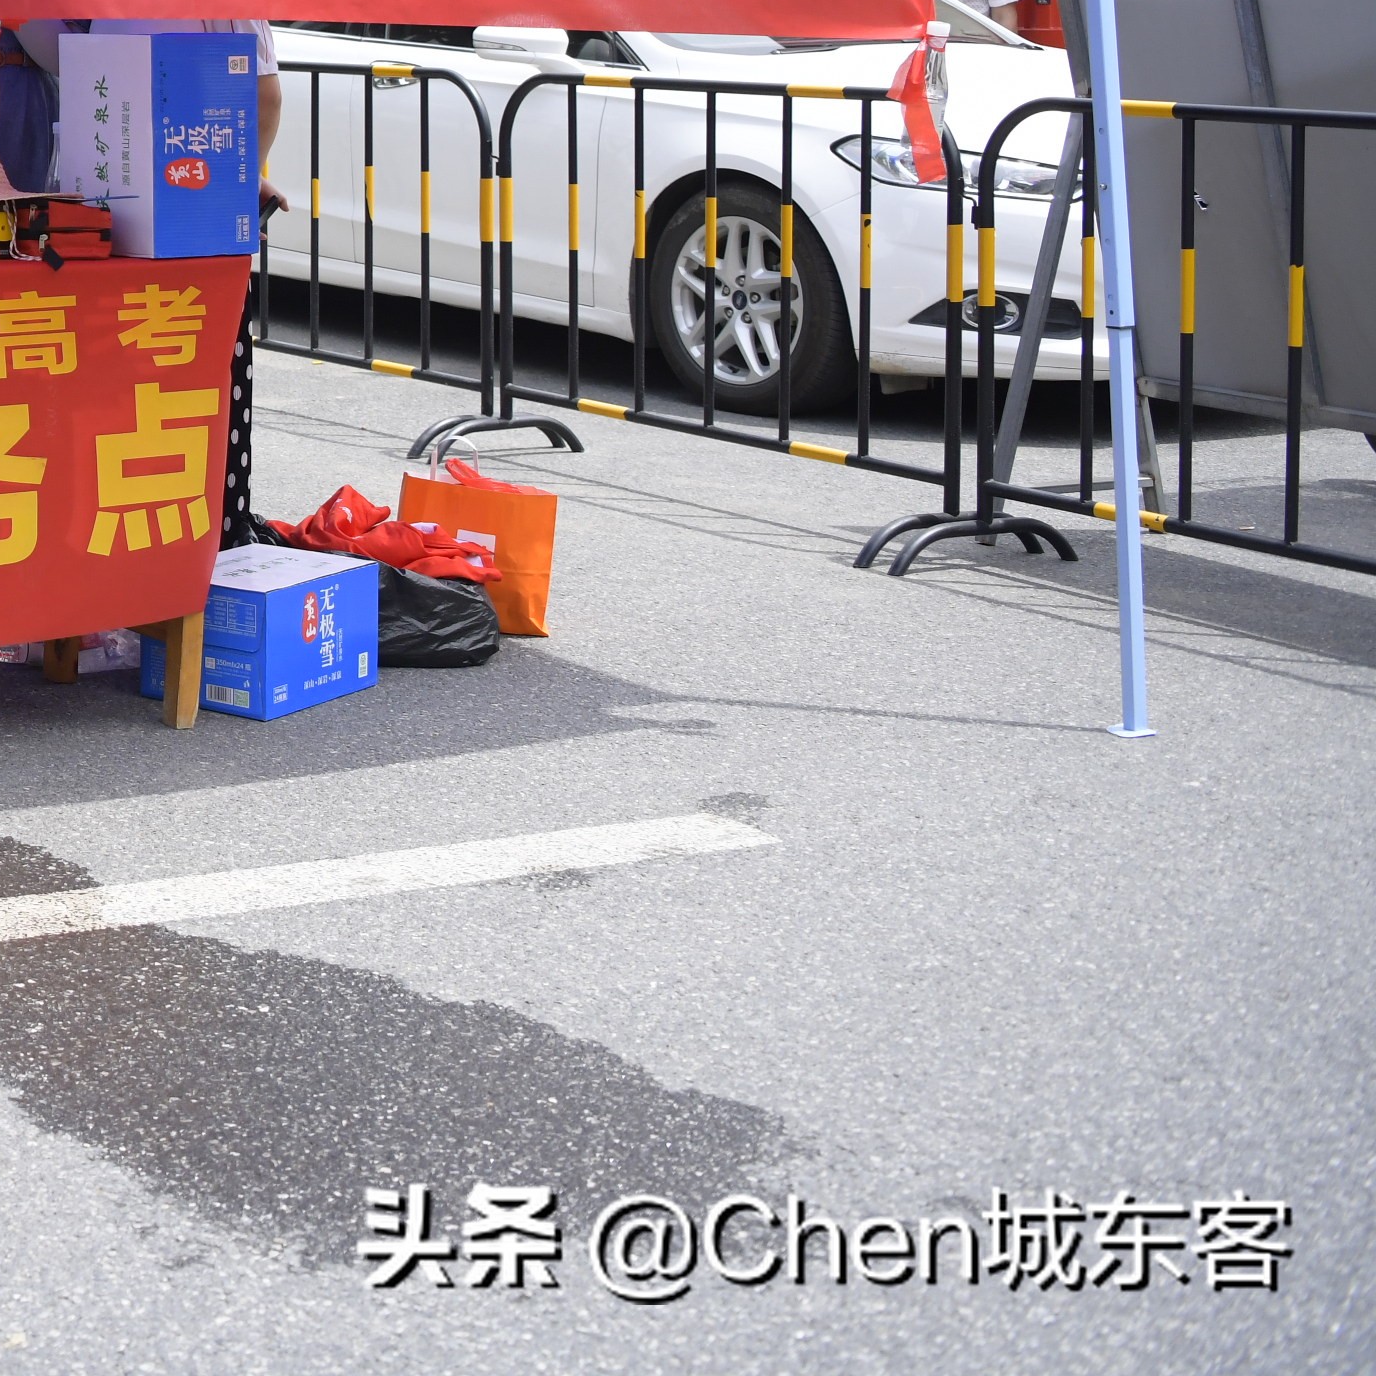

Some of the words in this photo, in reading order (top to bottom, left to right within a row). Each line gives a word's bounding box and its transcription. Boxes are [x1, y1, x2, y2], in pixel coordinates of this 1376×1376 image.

[164, 124, 233, 154] 无极雪
[304, 597, 317, 639] 黄山
[319, 586, 336, 668] 无极雪
